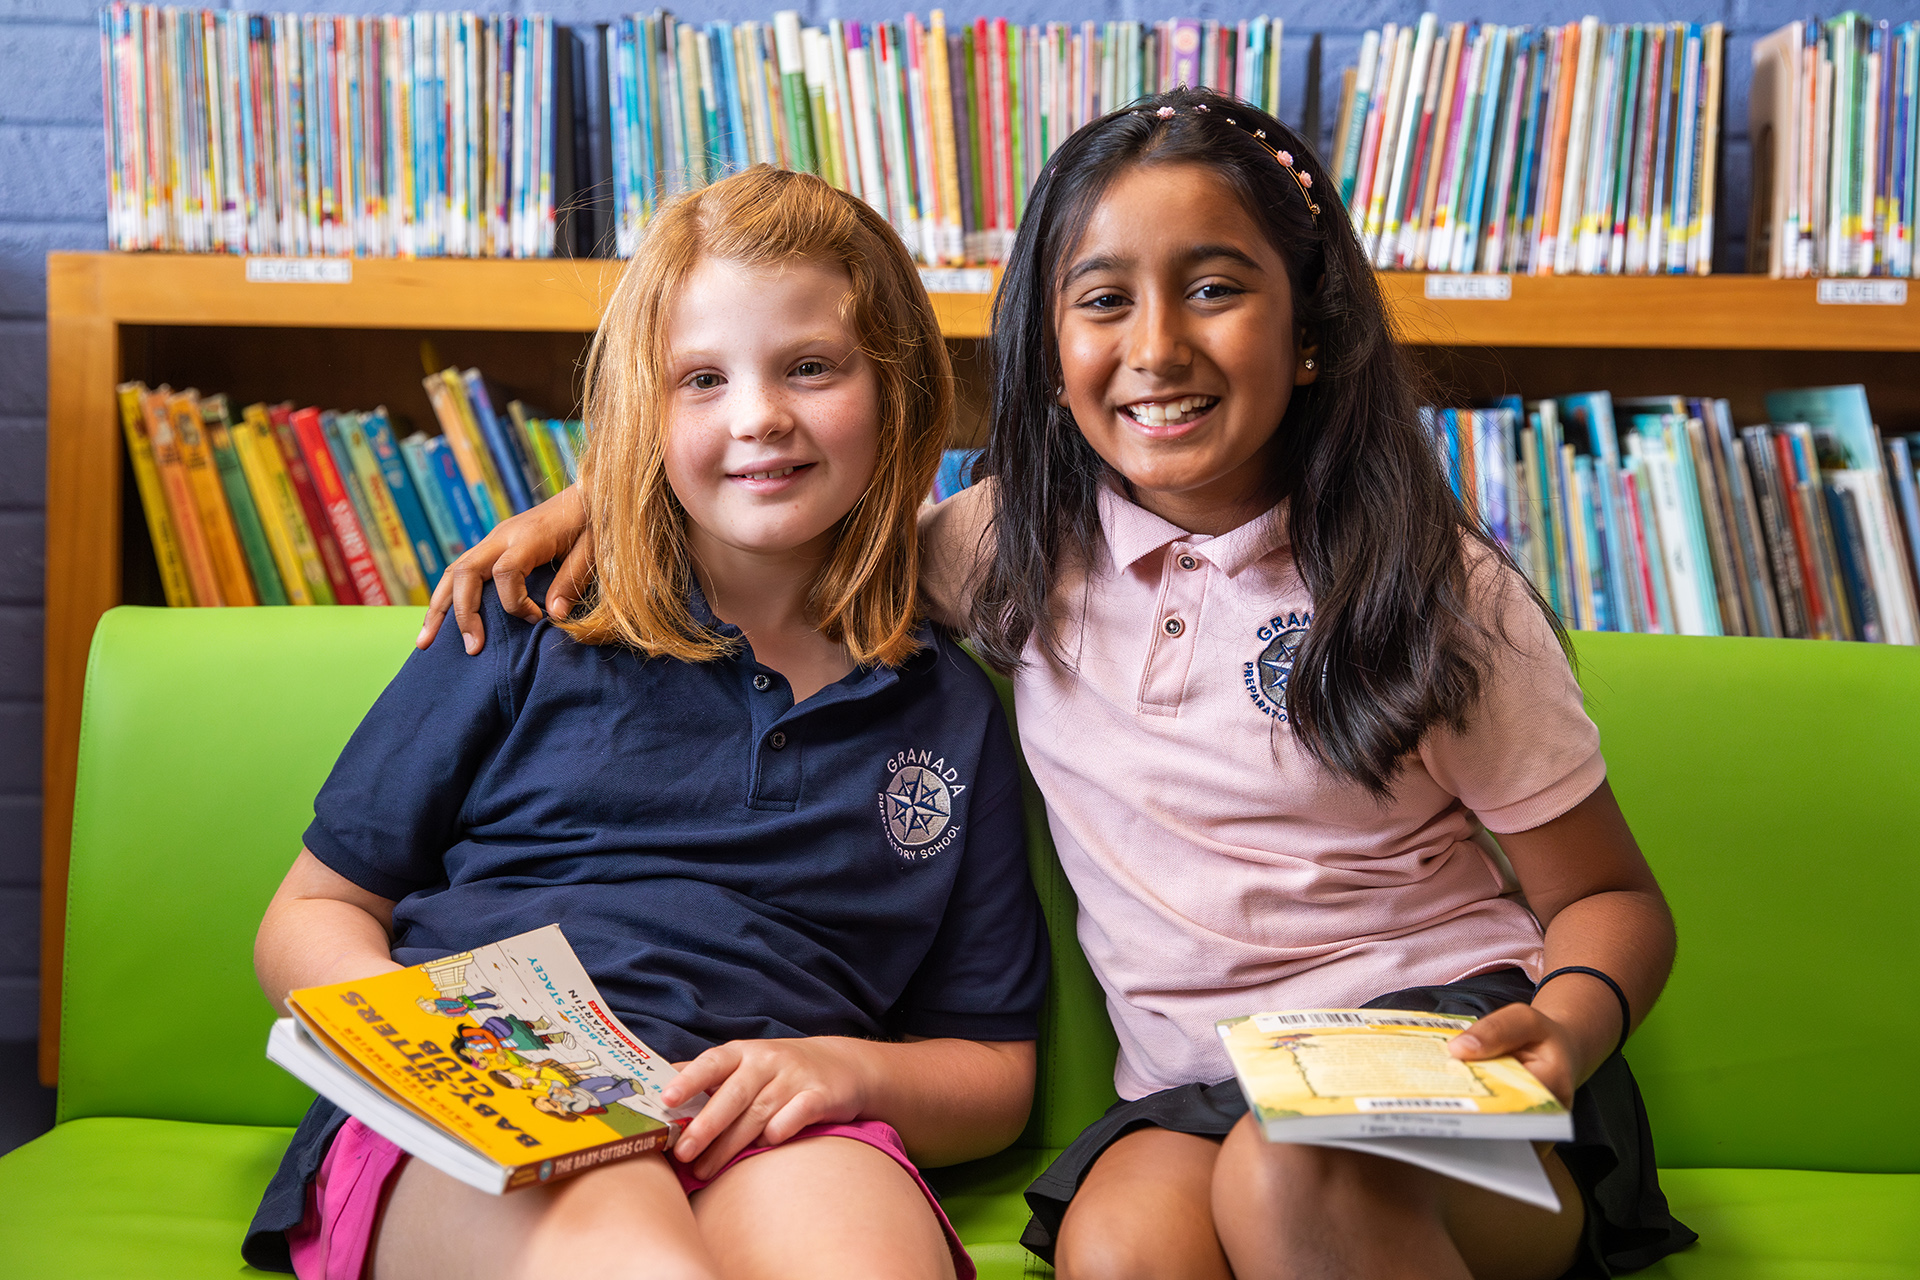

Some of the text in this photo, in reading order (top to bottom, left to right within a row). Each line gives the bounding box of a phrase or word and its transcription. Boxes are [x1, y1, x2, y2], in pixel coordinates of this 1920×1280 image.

[1427, 277, 1489, 297] LEVEL
[1820, 281, 1883, 303] LEVEL
[1256, 611, 1315, 642] GRAN
[1243, 661, 1289, 723] PREPARATO
[886, 747, 967, 797] GRANADA
[919, 825, 961, 859] SCHOOL
[527, 957, 649, 1082] TRUTH ABOUT STACEY
[568, 989, 655, 1072] ANN M. MARTIN
[589, 1001, 642, 1054] SCHOLASTIC
[339, 990, 543, 1149] BABY-SITTERS
[400, 1064, 438, 1091] THE
[417, 1040, 495, 1097] CLUB
[554, 1160, 574, 1175] THE
[574, 1144, 633, 1171] BABY-SITTERS
[633, 1136, 657, 1153] CLUB
